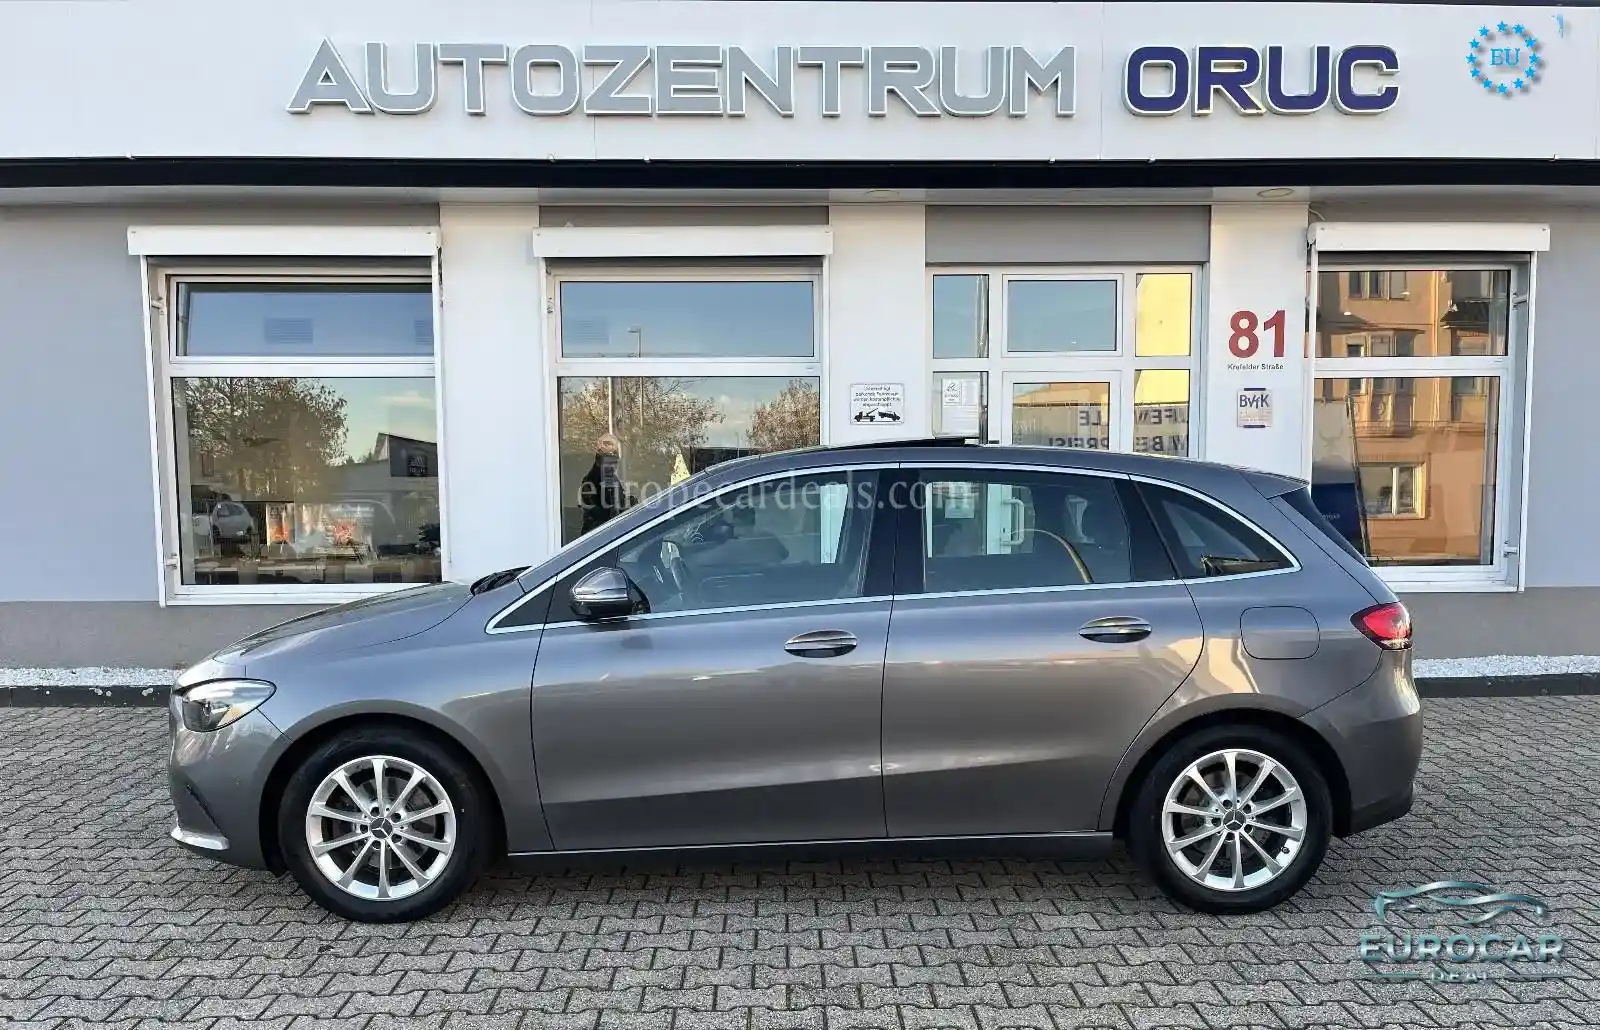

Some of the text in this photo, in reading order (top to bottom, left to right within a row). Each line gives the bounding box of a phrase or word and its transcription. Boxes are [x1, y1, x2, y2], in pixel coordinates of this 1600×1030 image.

[286, 37, 1400, 117] AUTOZENTRUM ORUC
[1489, 47, 1521, 68] EU
[1228, 309, 1286, 358] 81
